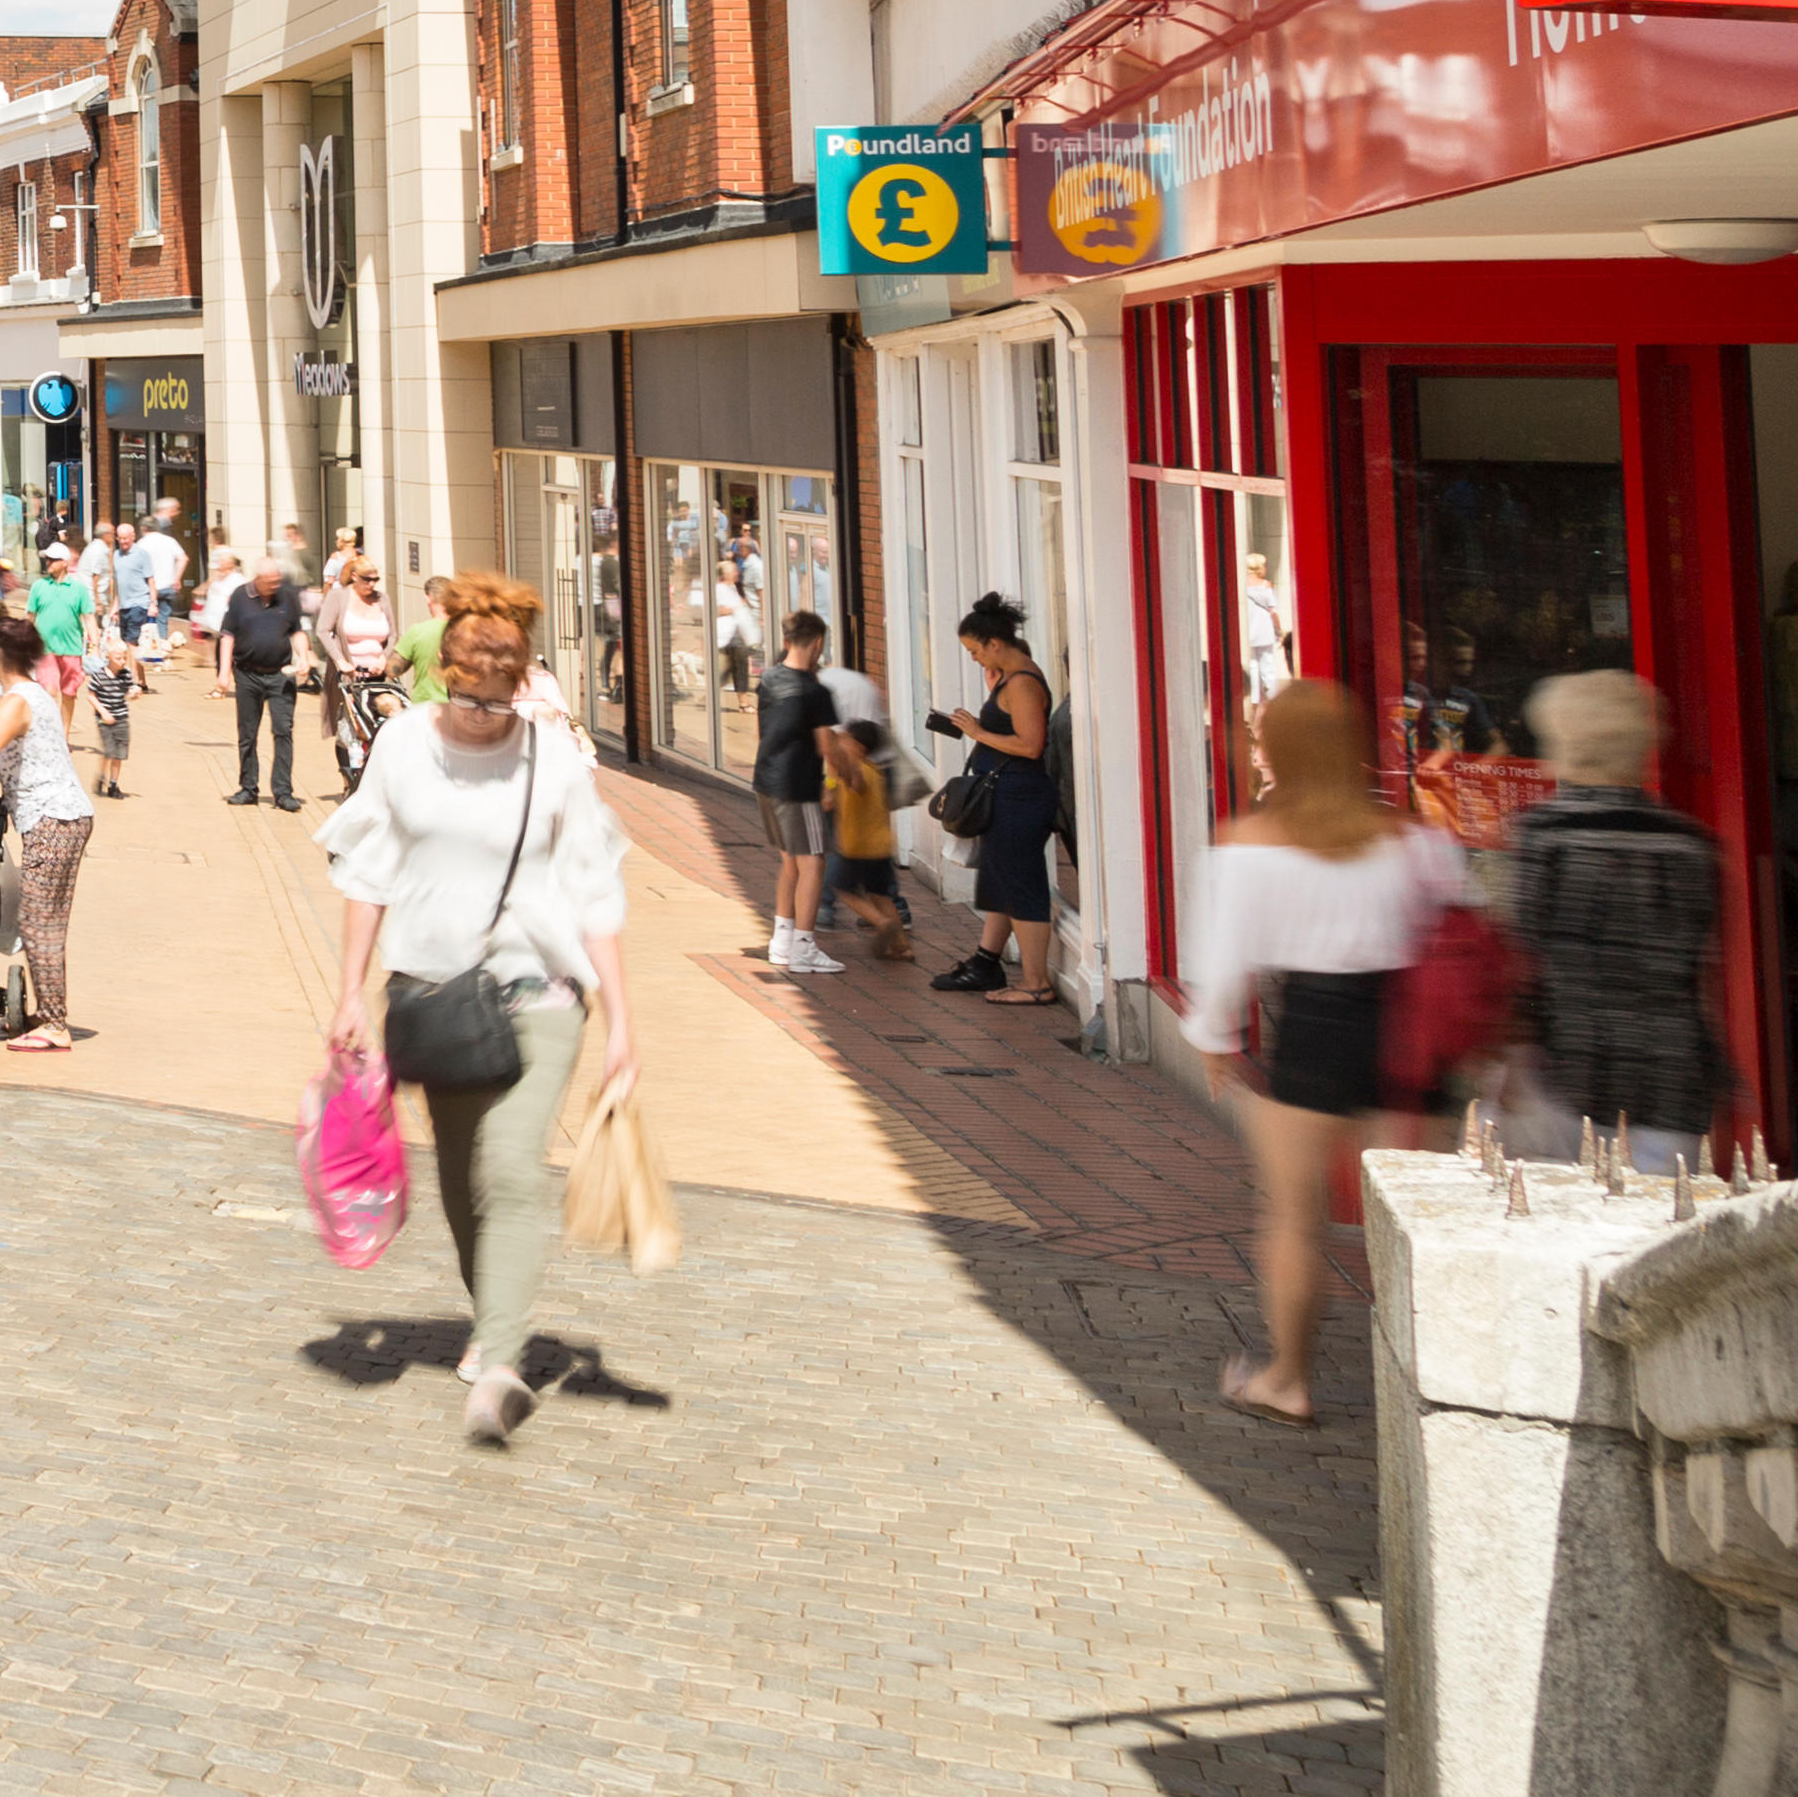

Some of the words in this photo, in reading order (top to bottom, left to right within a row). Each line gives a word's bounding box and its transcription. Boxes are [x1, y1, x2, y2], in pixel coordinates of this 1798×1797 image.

[826, 132, 972, 157] Poundland
[1054, 128, 1100, 230] British
[1100, 112, 1147, 213] Heart
[1149, 56, 1273, 196] Foundation
[143, 371, 189, 418] preto
[293, 349, 351, 397] Meadows
[1454, 761, 1506, 777] OPENING
[1508, 766, 1542, 780] TIMES
